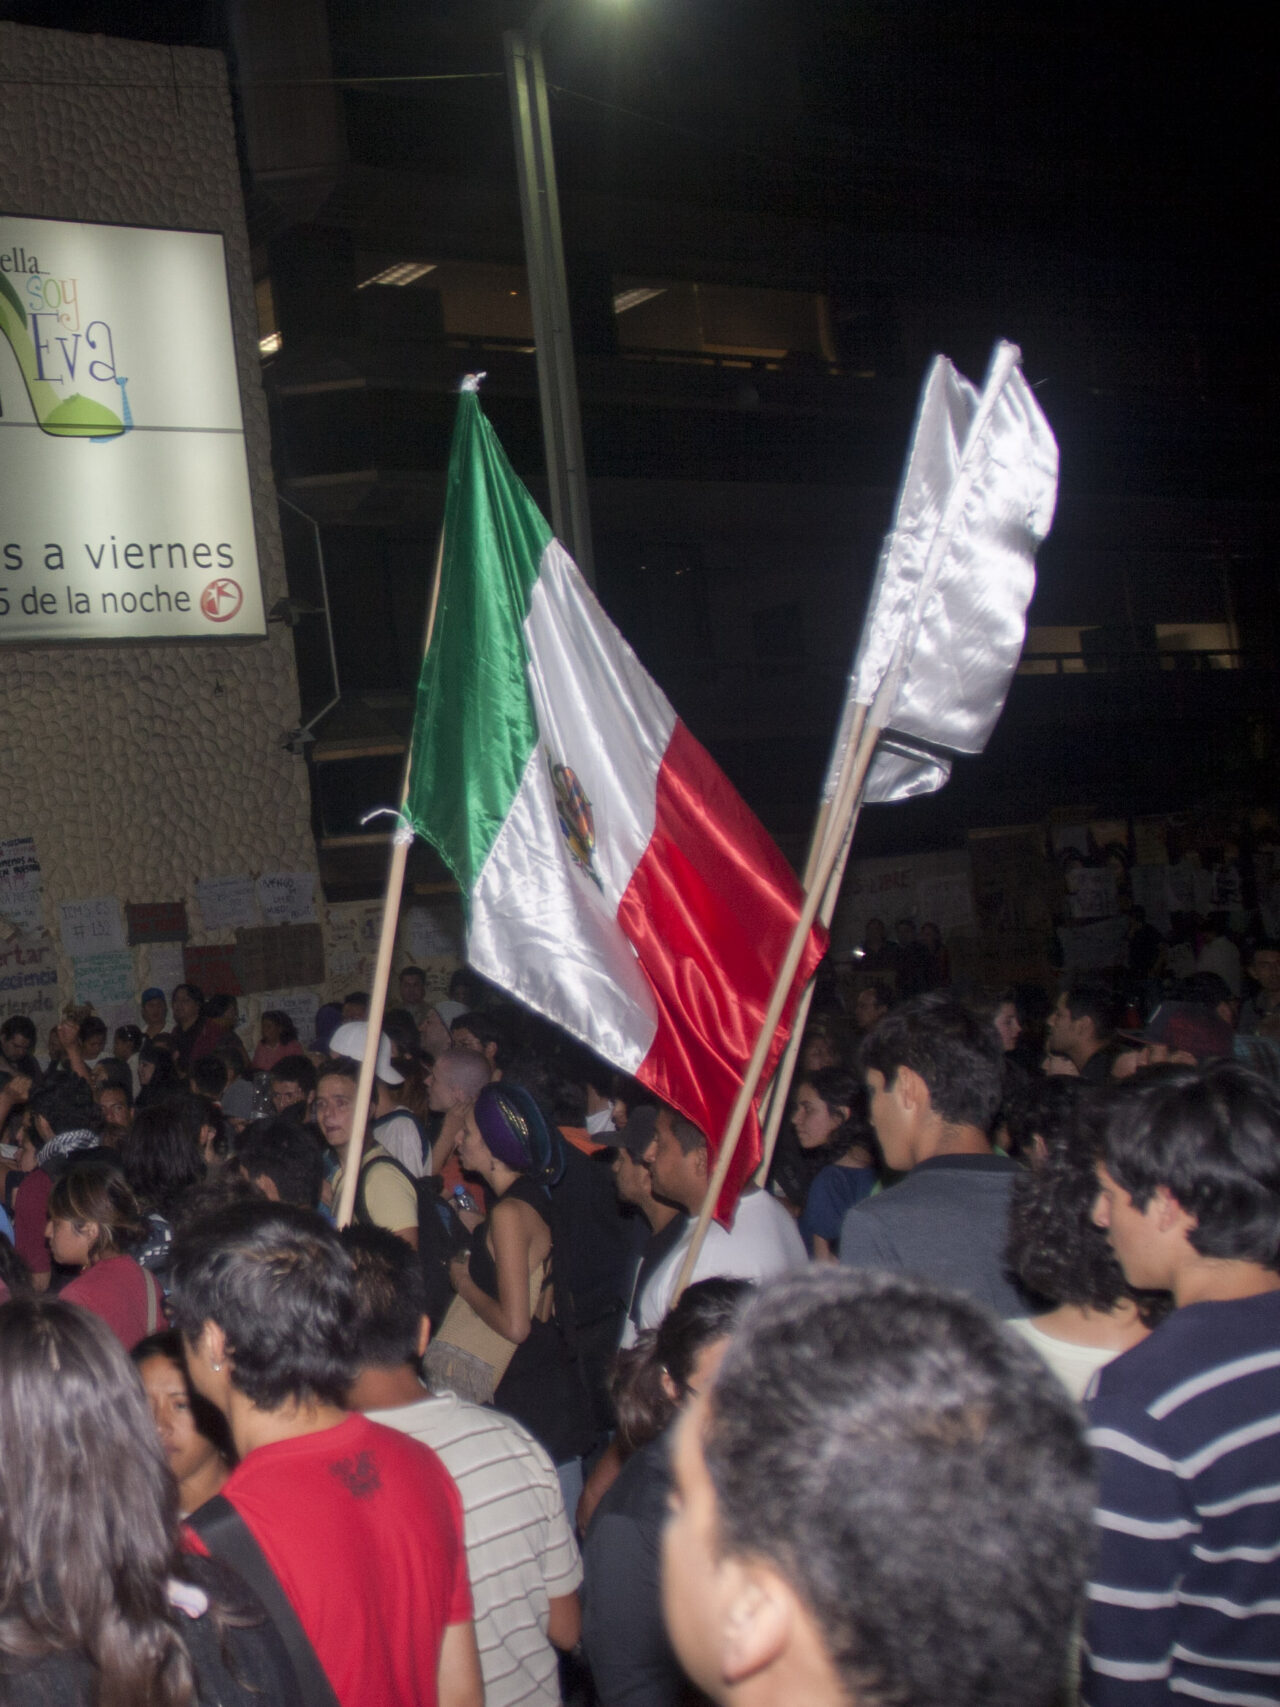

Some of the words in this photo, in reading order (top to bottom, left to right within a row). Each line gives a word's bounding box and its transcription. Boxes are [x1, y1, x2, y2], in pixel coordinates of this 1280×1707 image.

[28, 310, 118, 385] Eva
[44, 542, 64, 570] a
[85, 535, 235, 570] viernes
[21, 587, 57, 615] de
[67, 586, 90, 614] la
[101, 585, 192, 612] noche
